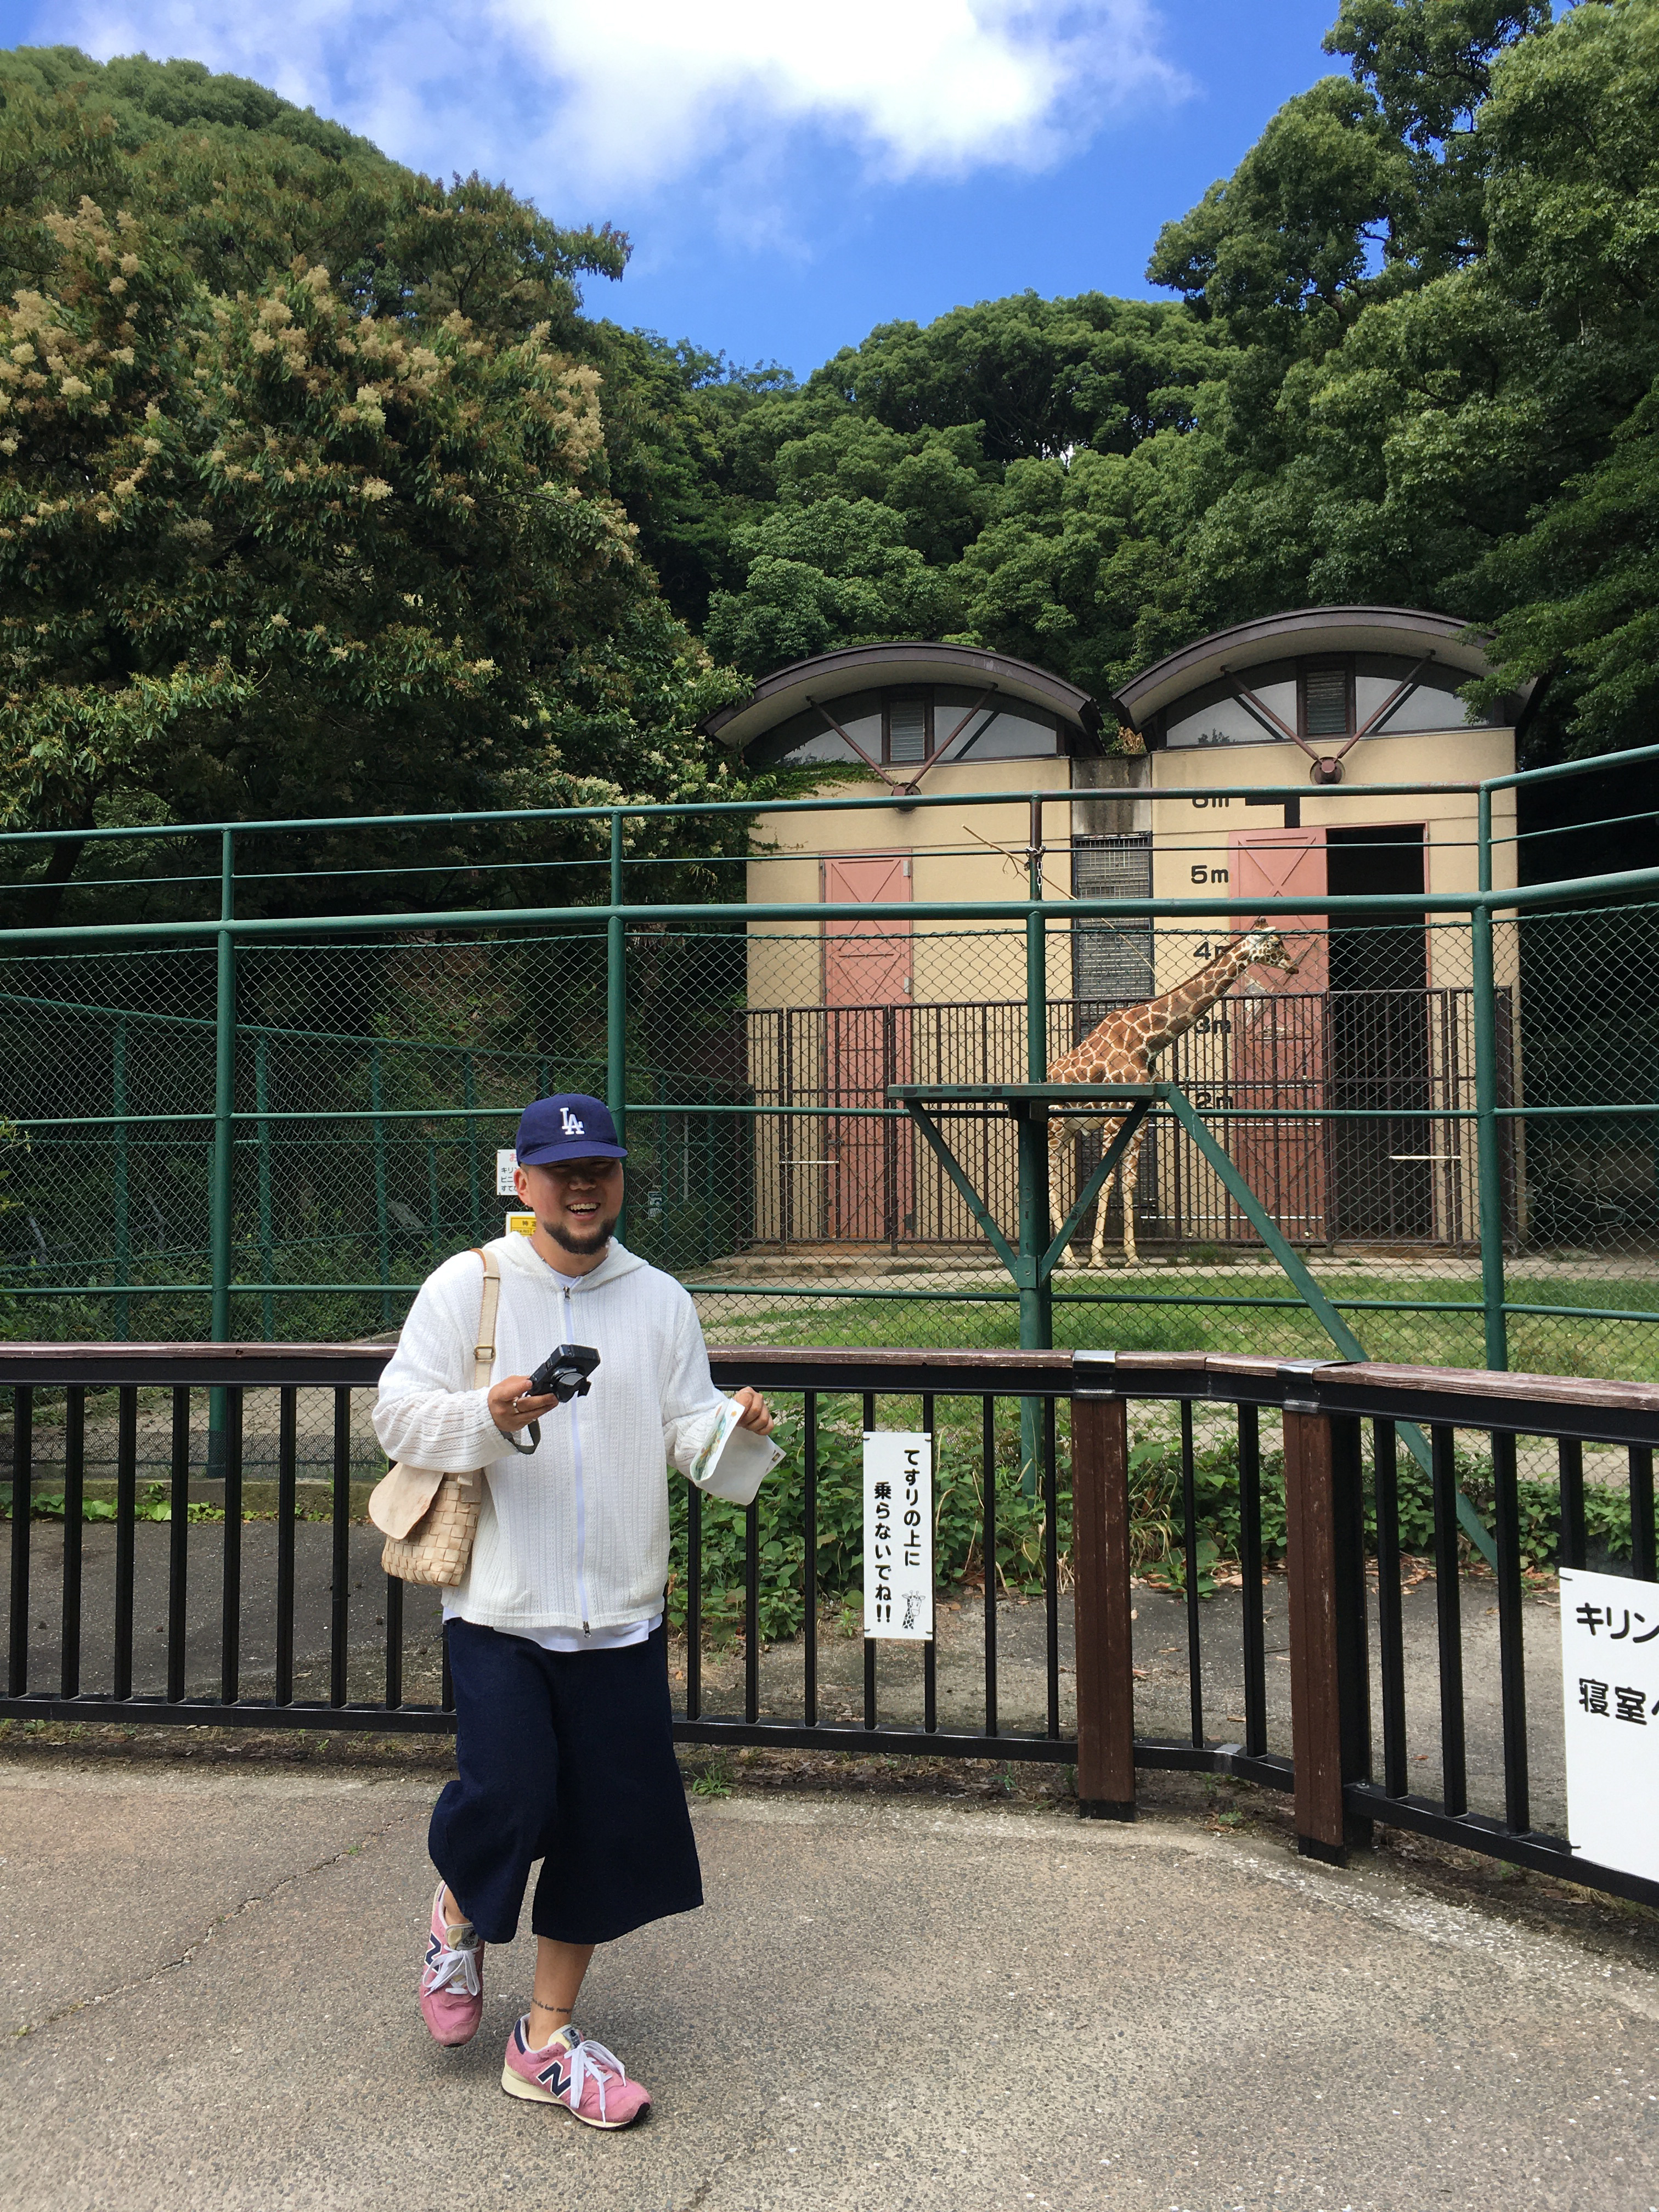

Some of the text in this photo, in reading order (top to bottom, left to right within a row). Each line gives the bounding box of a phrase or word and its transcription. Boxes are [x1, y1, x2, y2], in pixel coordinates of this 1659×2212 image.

[1191, 865, 1229, 884] 5m
[1197, 1092, 1233, 1109] 2m
[560, 1107, 585, 1135] LA
[904, 1449, 921, 1566] てすりの上に
[1579, 1678, 1659, 1725] 寝室
[536, 2060, 571, 2098] N
